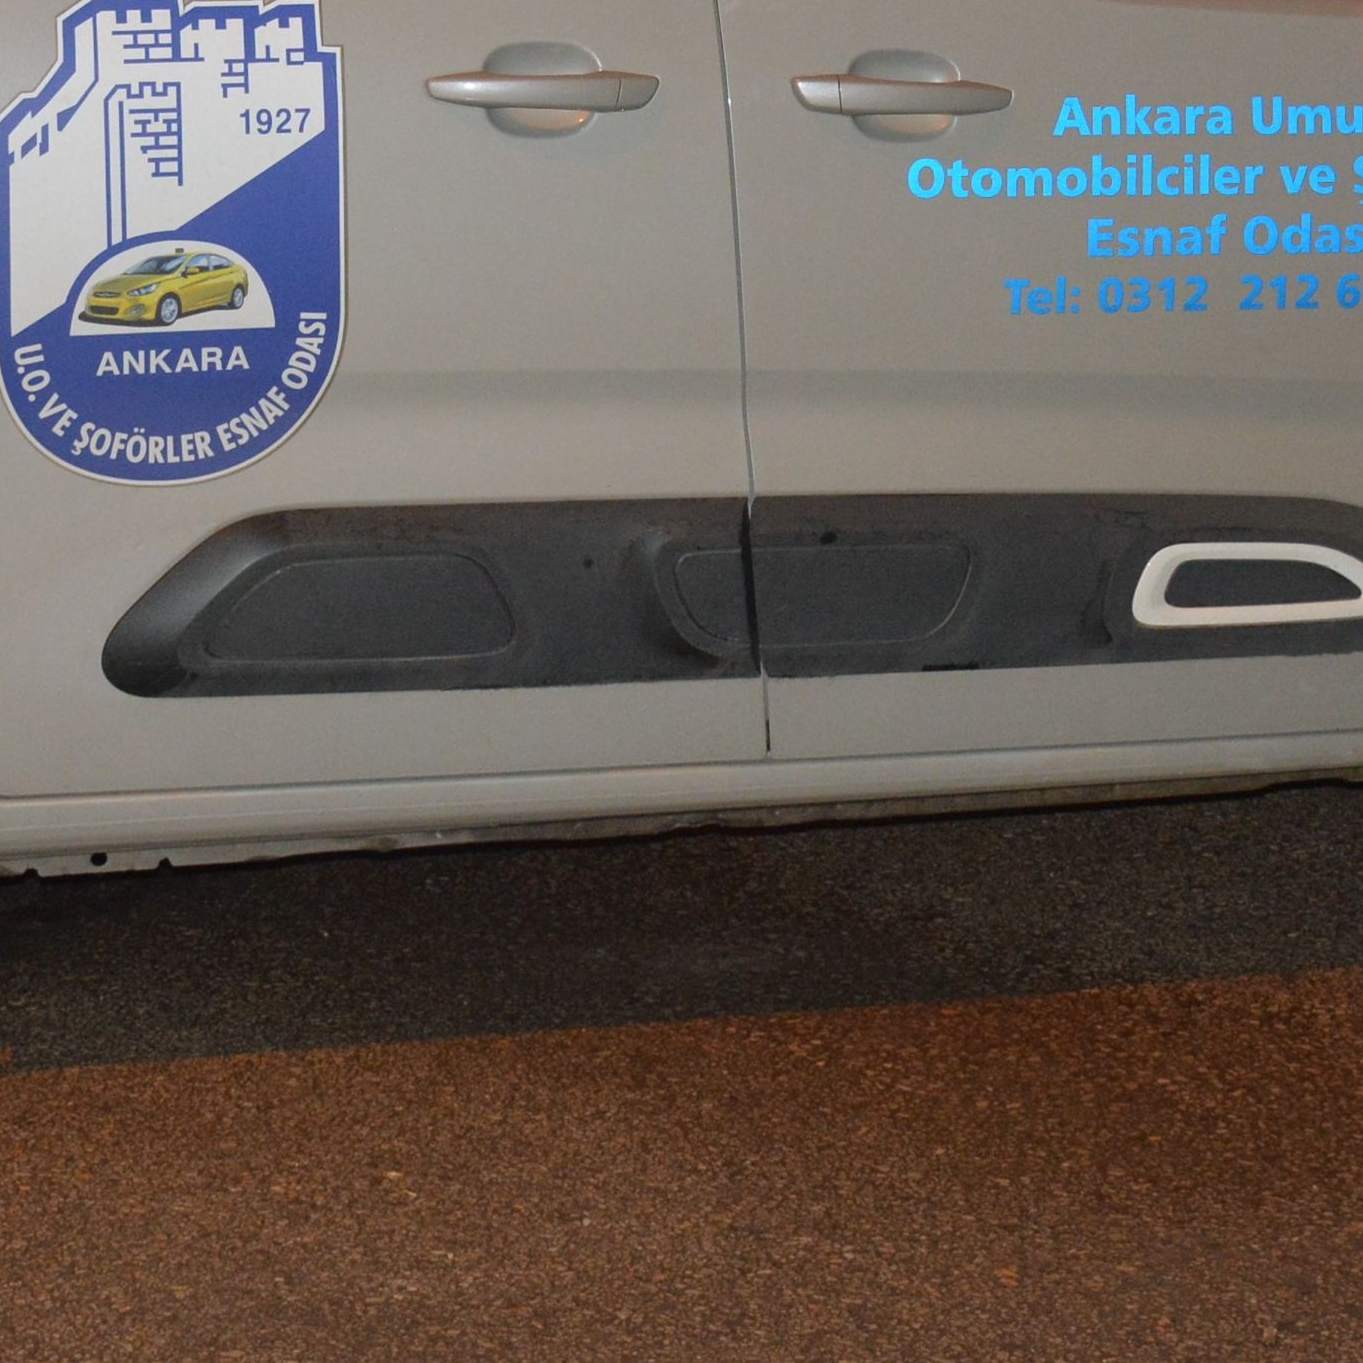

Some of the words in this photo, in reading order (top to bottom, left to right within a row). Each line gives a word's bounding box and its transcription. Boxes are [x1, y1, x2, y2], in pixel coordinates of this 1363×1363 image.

[238, 107, 312, 135] 1927
[1053, 95, 1233, 137] Ankara
[907, 154, 1264, 200] Otomobilciler
[1280, 163, 1337, 195] ve
[1087, 214, 1228, 258] Esnaf
[1004, 276, 1081, 315] Tel:
[1097, 274, 1209, 314] 0312
[1239, 273, 1319, 311] 212
[95, 344, 251, 377] ANKARA
[13, 341, 52, 404] U.O.
[37, 394, 78, 436] VE
[71, 420, 215, 465] ŞOFÖRLER
[215, 385, 292, 452] ESNAF
[280, 310, 329, 393] ODASI
